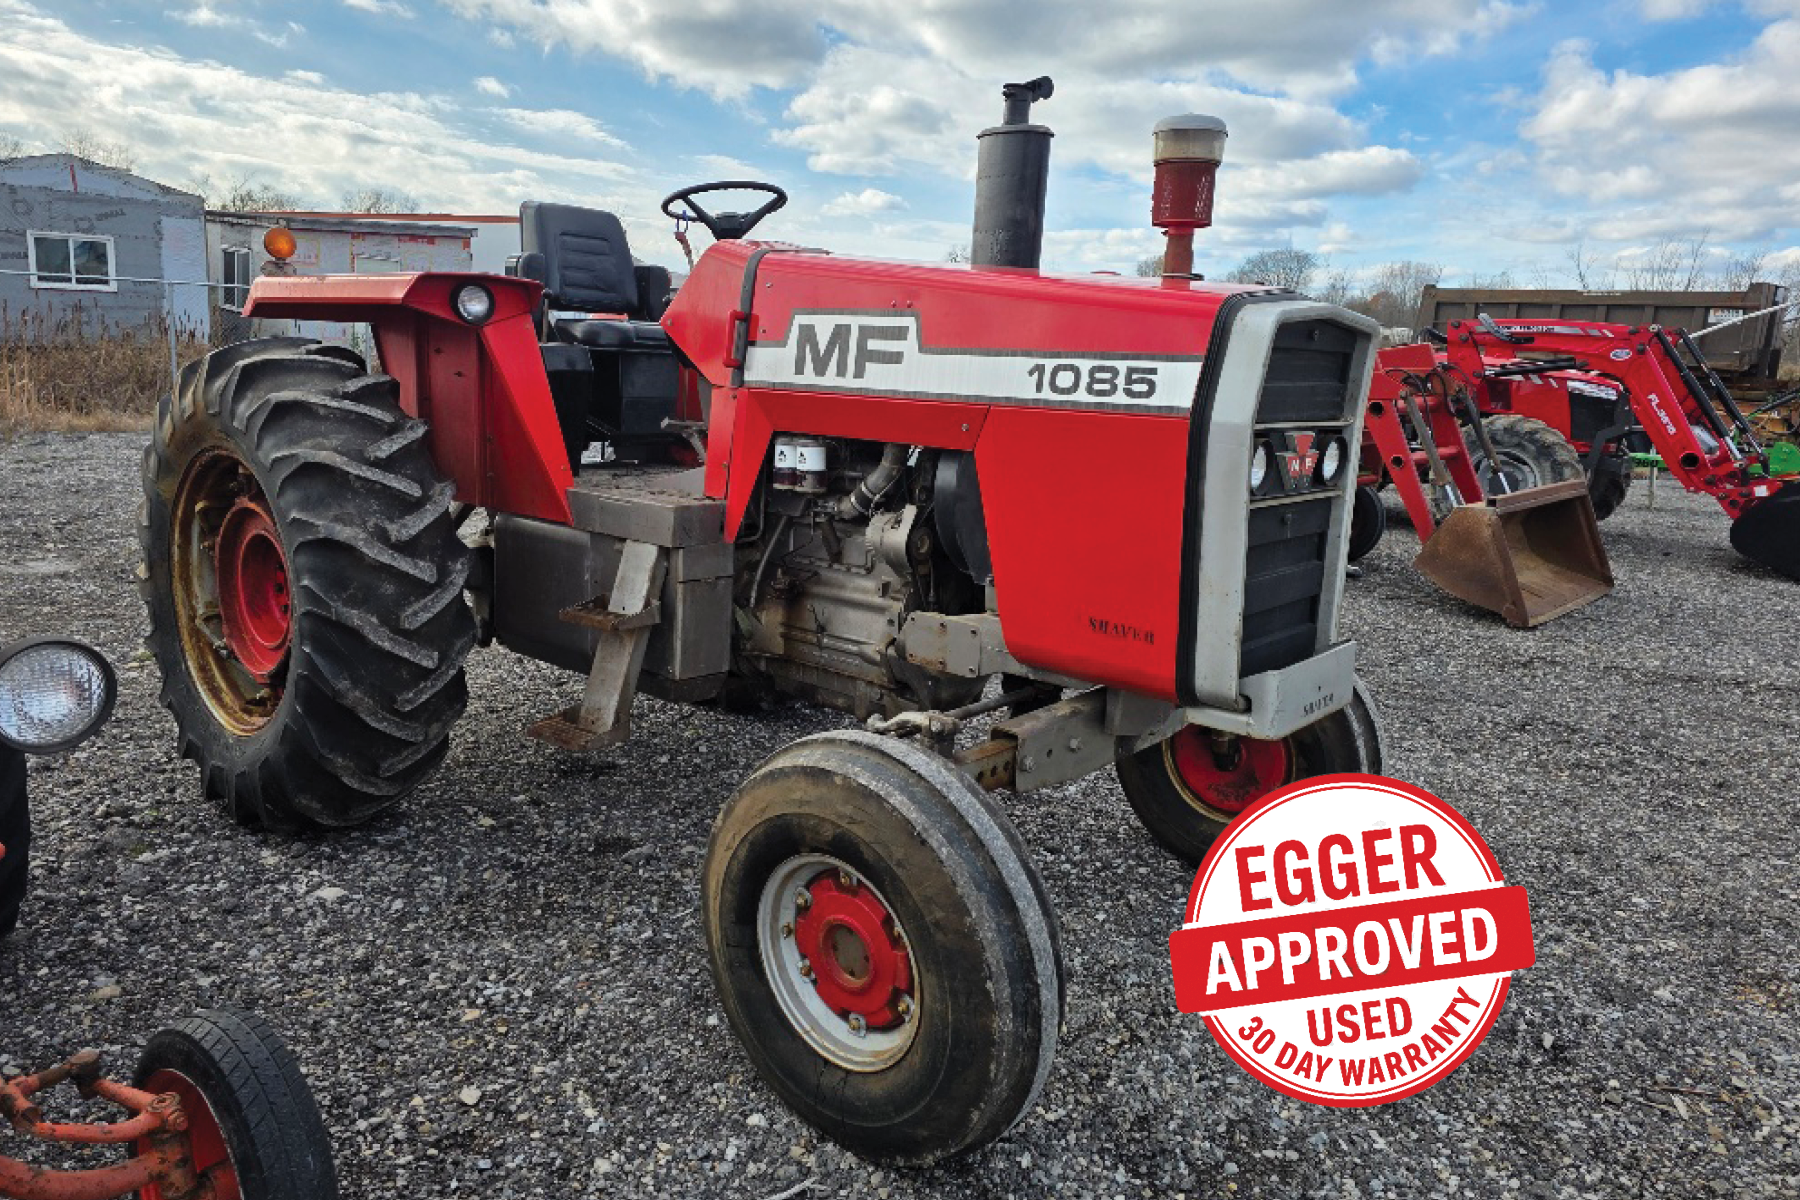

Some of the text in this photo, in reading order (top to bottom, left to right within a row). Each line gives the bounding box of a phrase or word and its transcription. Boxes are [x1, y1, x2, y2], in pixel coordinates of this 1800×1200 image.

[794, 323, 910, 380] MF
[1027, 363, 1158, 399] 1085
[1088, 616, 1155, 646] SHAVER
